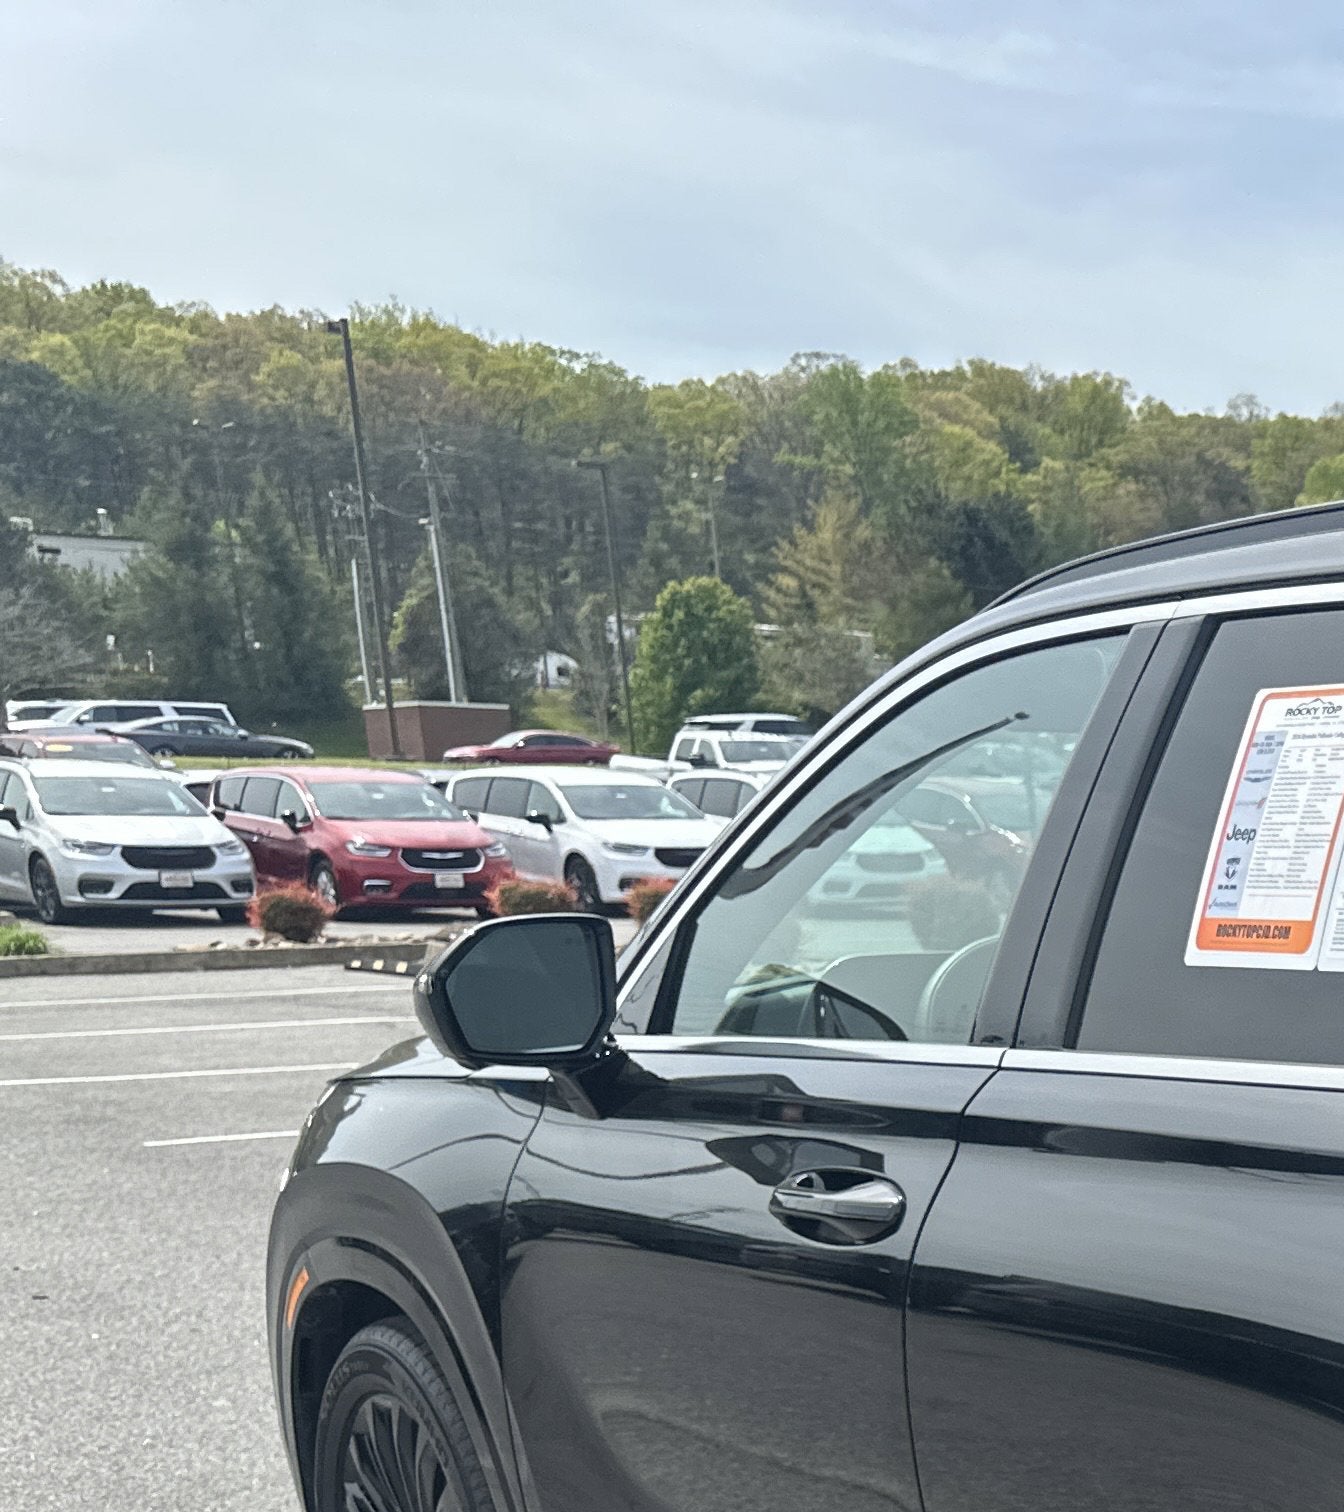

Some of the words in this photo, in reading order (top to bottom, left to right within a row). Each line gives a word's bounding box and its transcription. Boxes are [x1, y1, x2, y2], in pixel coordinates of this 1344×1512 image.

[1285, 708, 1318, 717] ROCKY
[1321, 705, 1343, 714] TOP
[1226, 824, 1257, 844] Jeep
